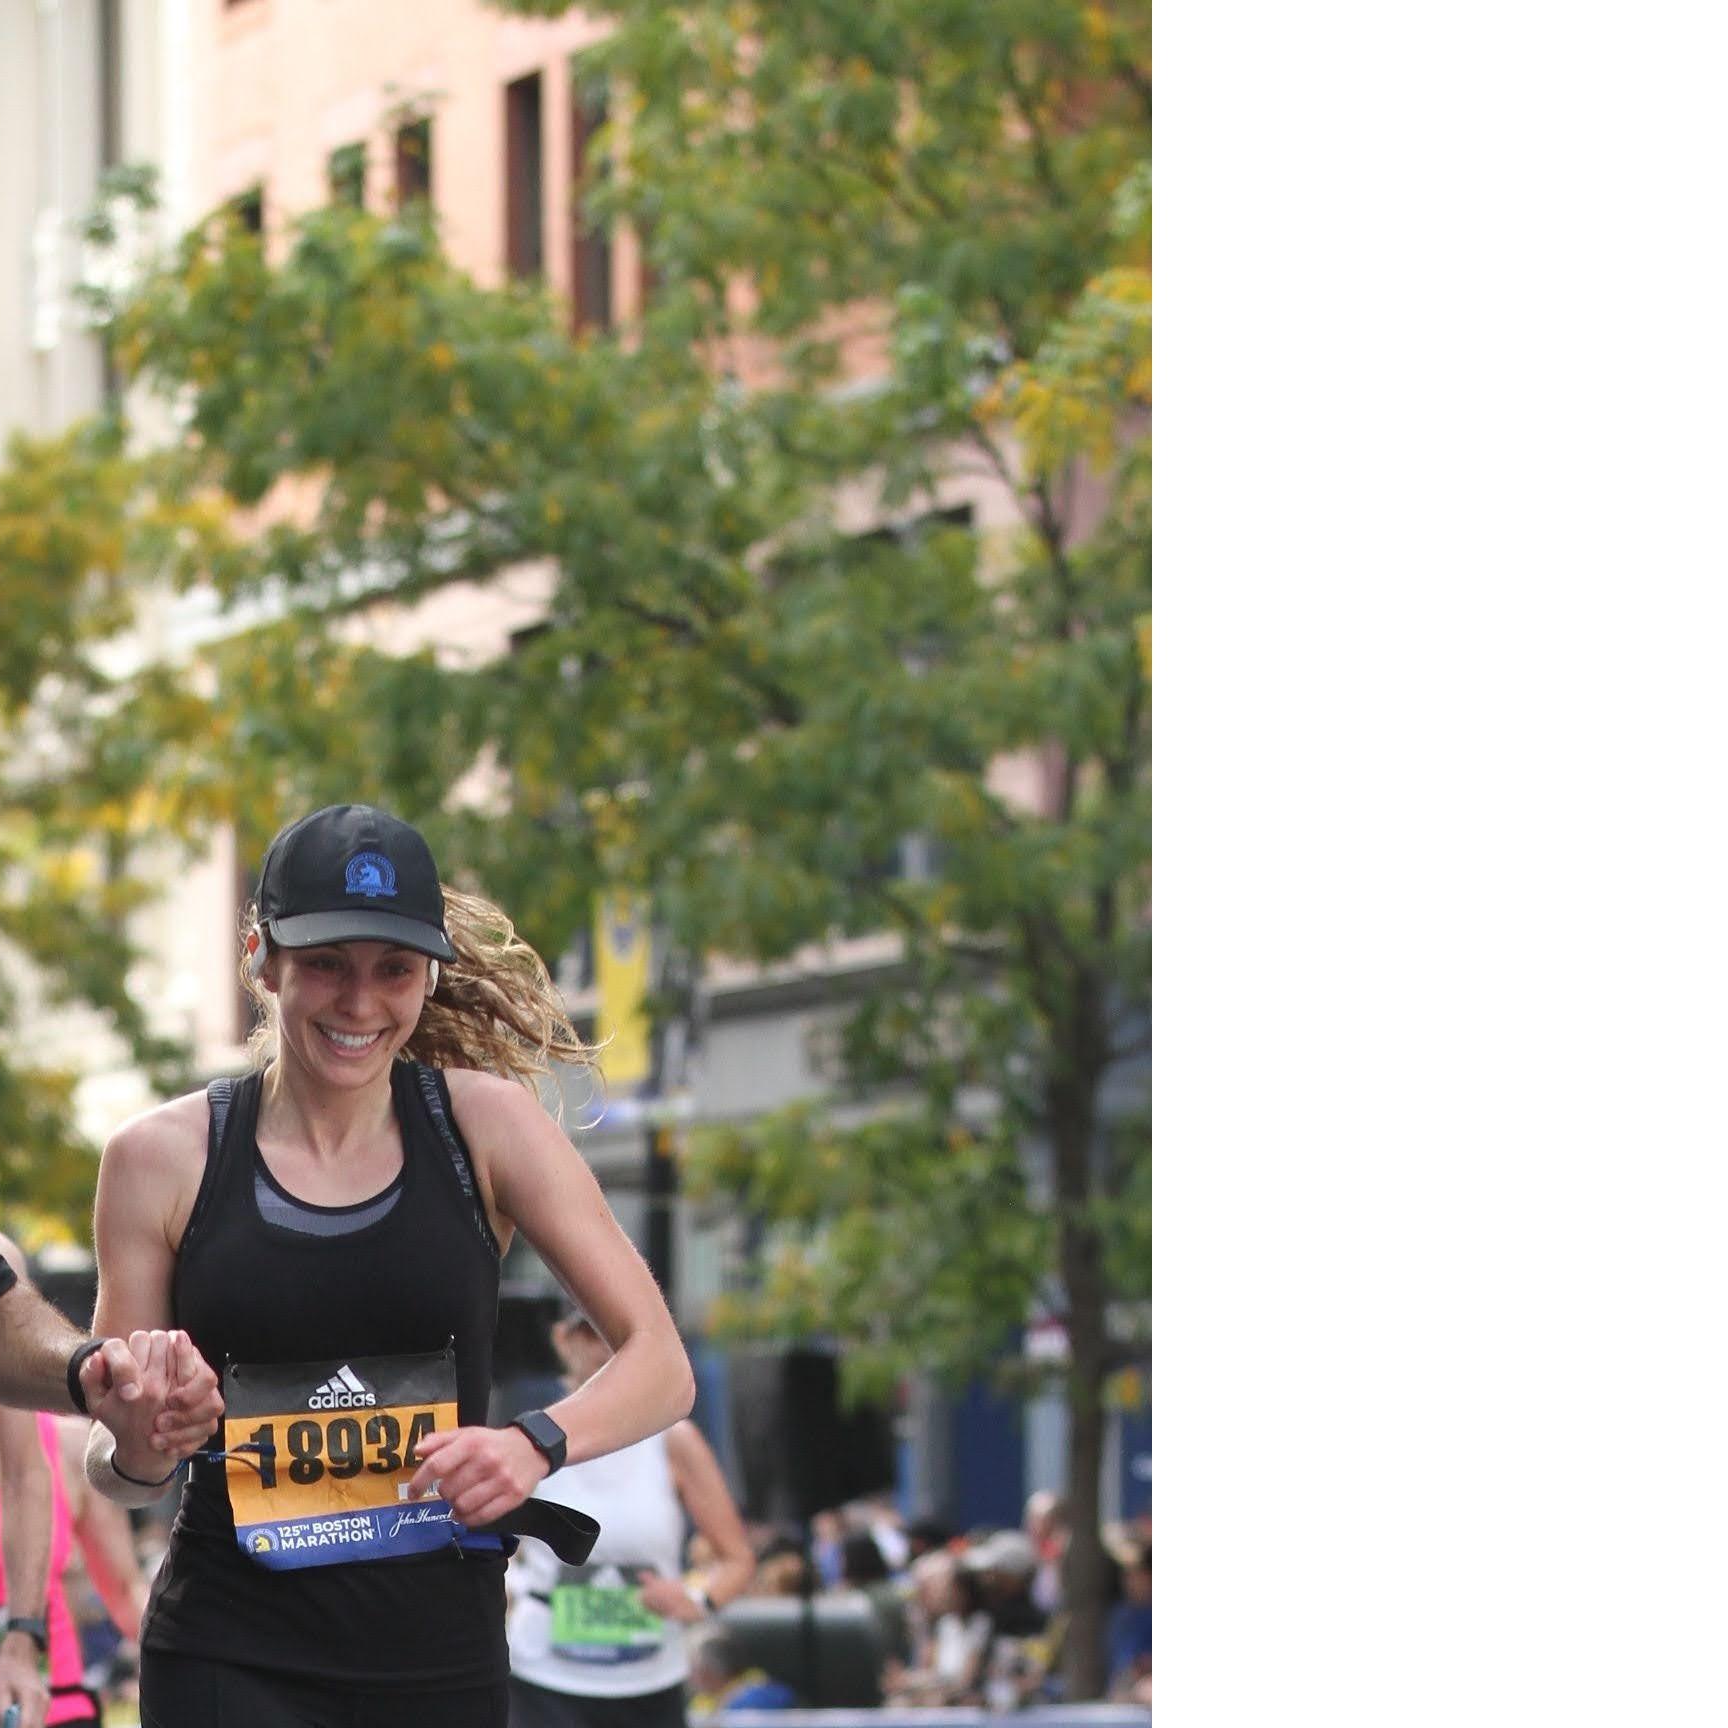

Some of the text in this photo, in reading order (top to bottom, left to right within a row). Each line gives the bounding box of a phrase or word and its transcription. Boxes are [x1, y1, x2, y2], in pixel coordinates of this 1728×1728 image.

[308, 1391, 376, 1410] adidas
[277, 1515, 372, 1538] 125TH BOSTON
[281, 1528, 374, 1551] MARATHON
